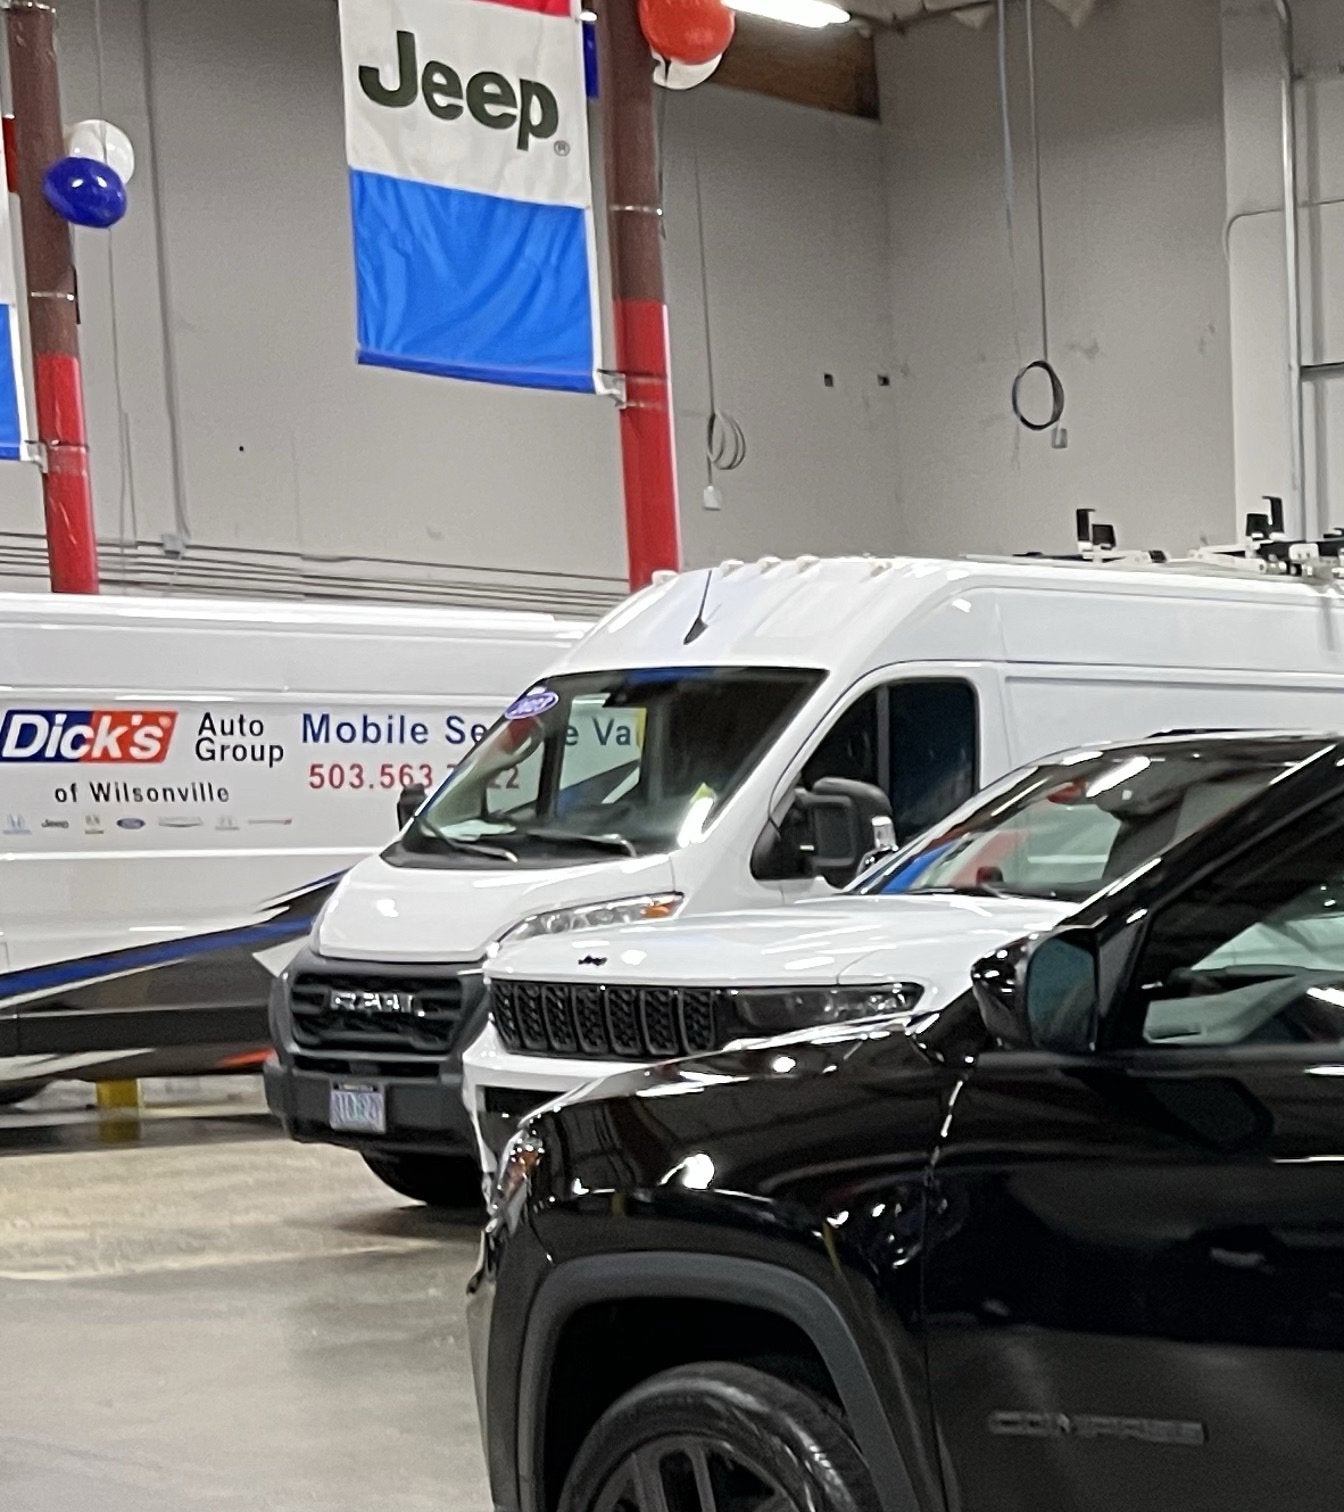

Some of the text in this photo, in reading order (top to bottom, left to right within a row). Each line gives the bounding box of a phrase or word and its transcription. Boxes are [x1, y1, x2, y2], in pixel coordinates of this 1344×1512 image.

[358, 30, 559, 151] Jeep
[1, 713, 165, 760] Dick's
[197, 711, 265, 737] Auto
[302, 713, 430, 745] Mobile
[194, 737, 285, 768] Group
[54, 782, 230, 803] of Wilsonville
